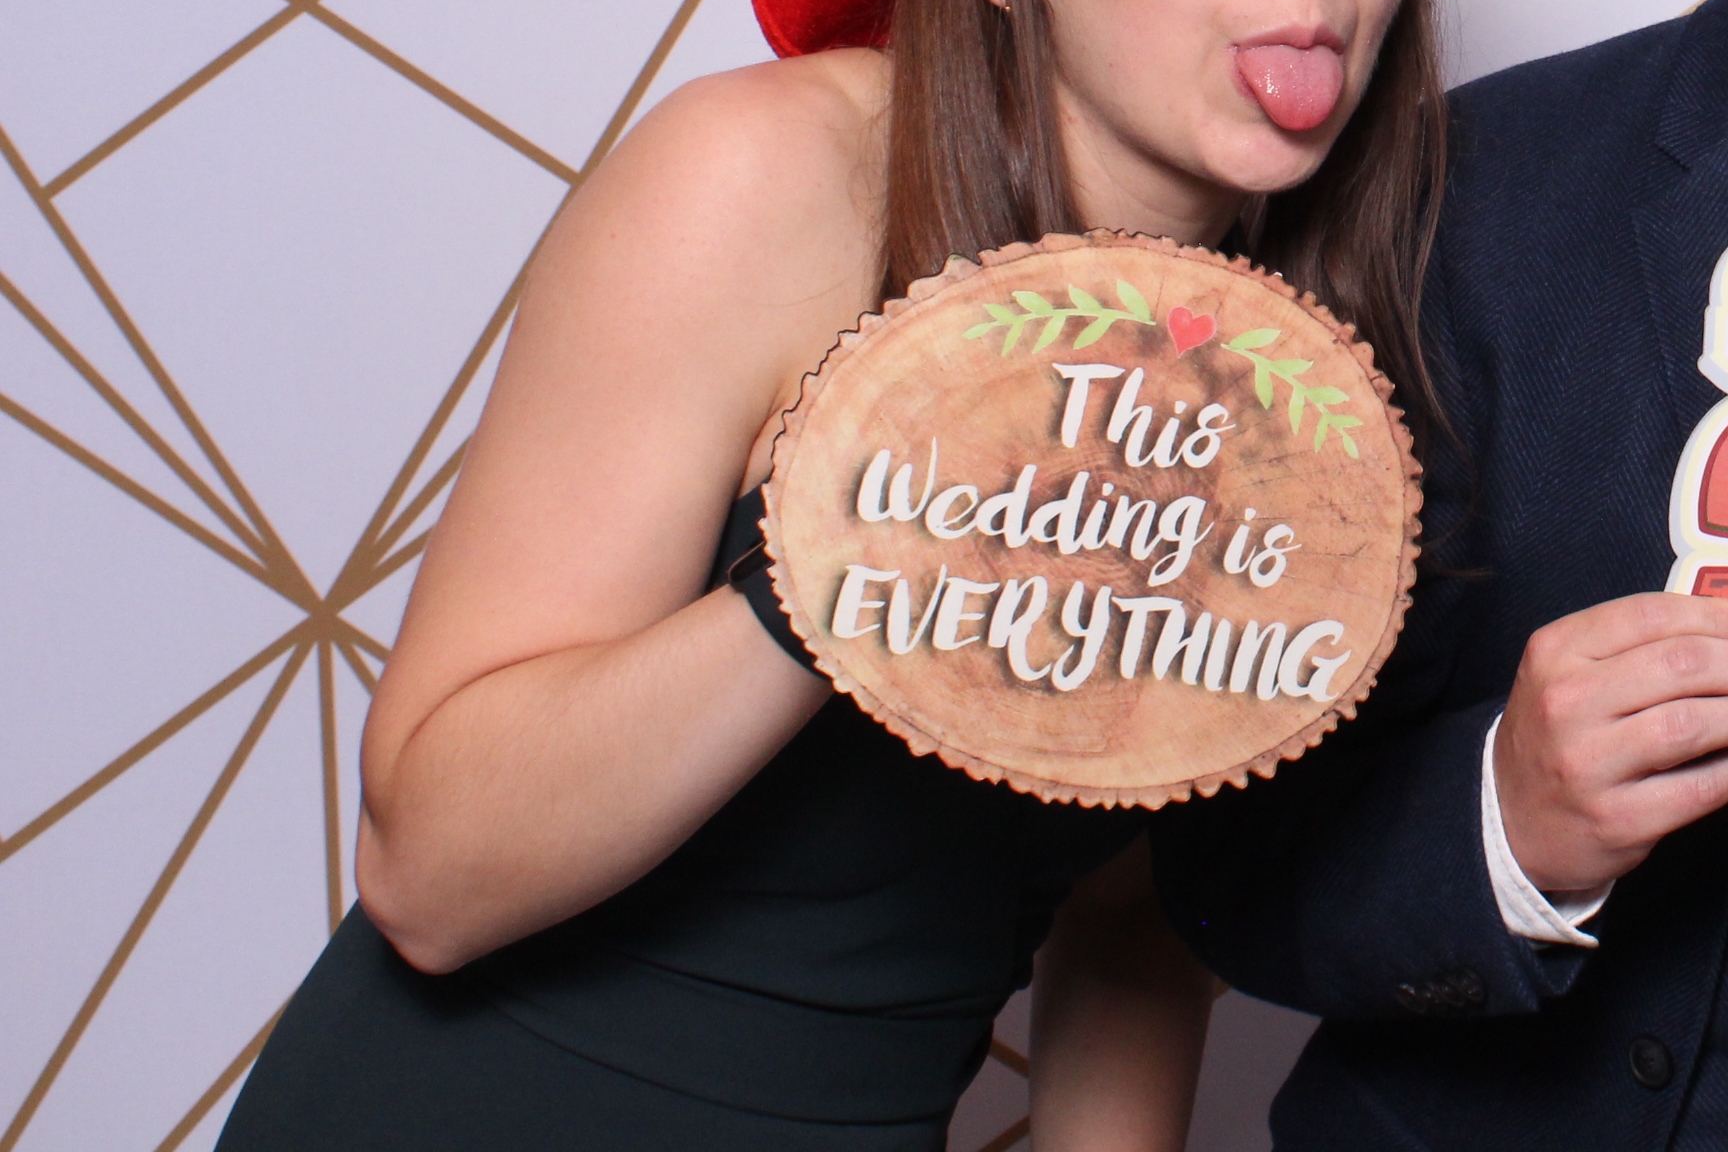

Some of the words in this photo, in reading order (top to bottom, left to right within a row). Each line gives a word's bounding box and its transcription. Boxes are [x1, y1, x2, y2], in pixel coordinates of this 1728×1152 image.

[1052, 361, 1237, 468] This
[856, 436, 1215, 588] Wedding
[1222, 506, 1303, 588] is
[830, 563, 1352, 702] EVERYTHING
